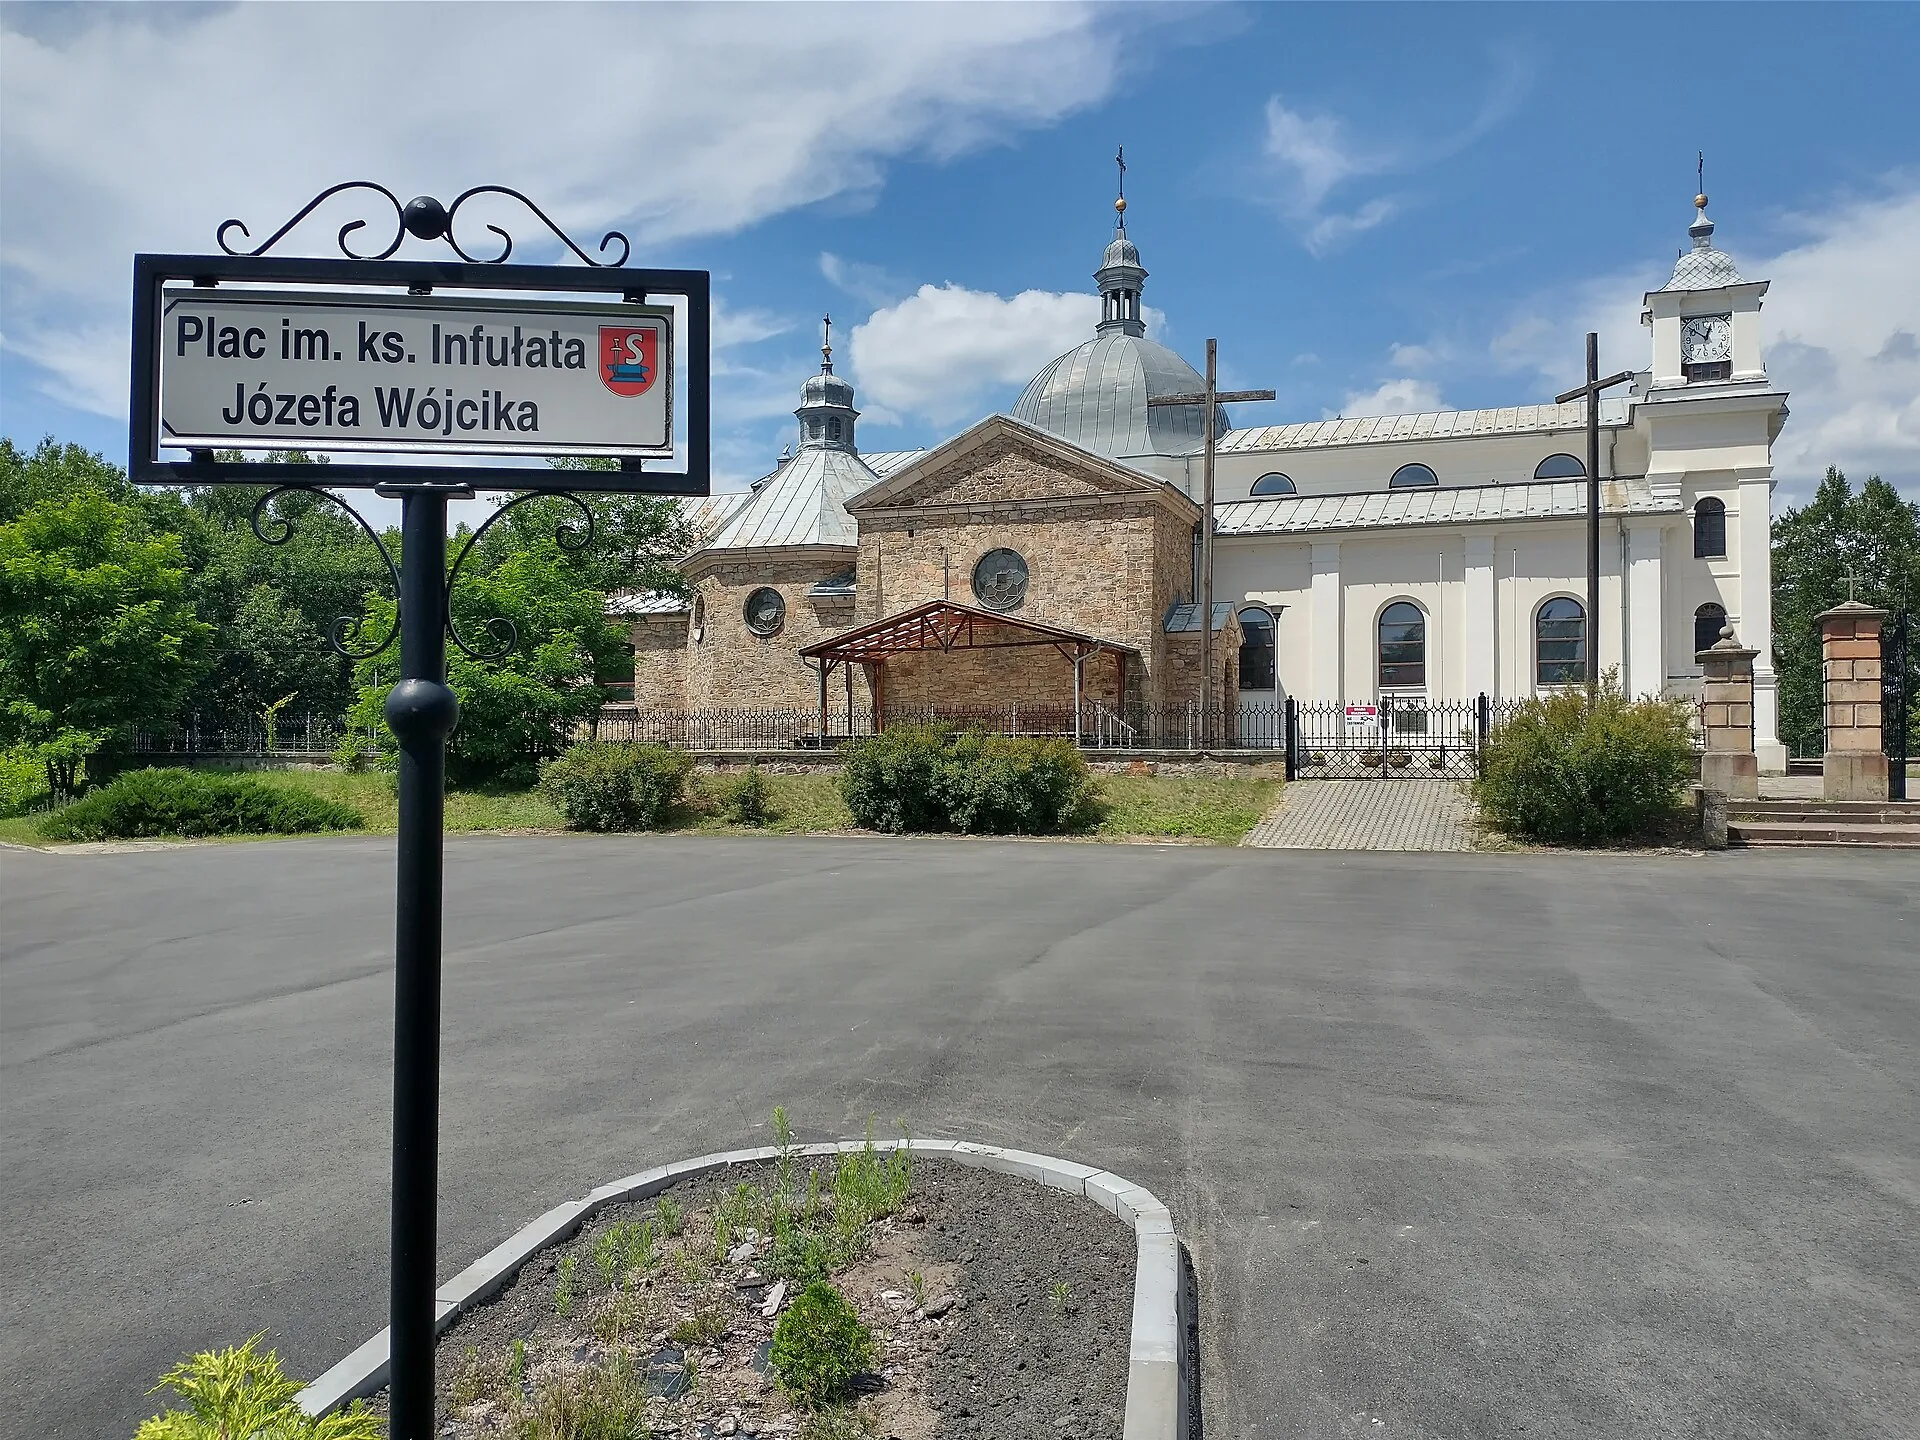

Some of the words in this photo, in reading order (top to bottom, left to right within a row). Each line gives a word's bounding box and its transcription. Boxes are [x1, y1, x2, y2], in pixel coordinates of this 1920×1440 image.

[177, 315, 267, 359] Plac
[281, 318, 342, 361] im.
[358, 321, 416, 363] ks.
[432, 323, 587, 369] Infułata
[1718, 341, 1723, 349] 4
[222, 382, 361, 427] Józefa
[374, 386, 540, 435] Wójcika
